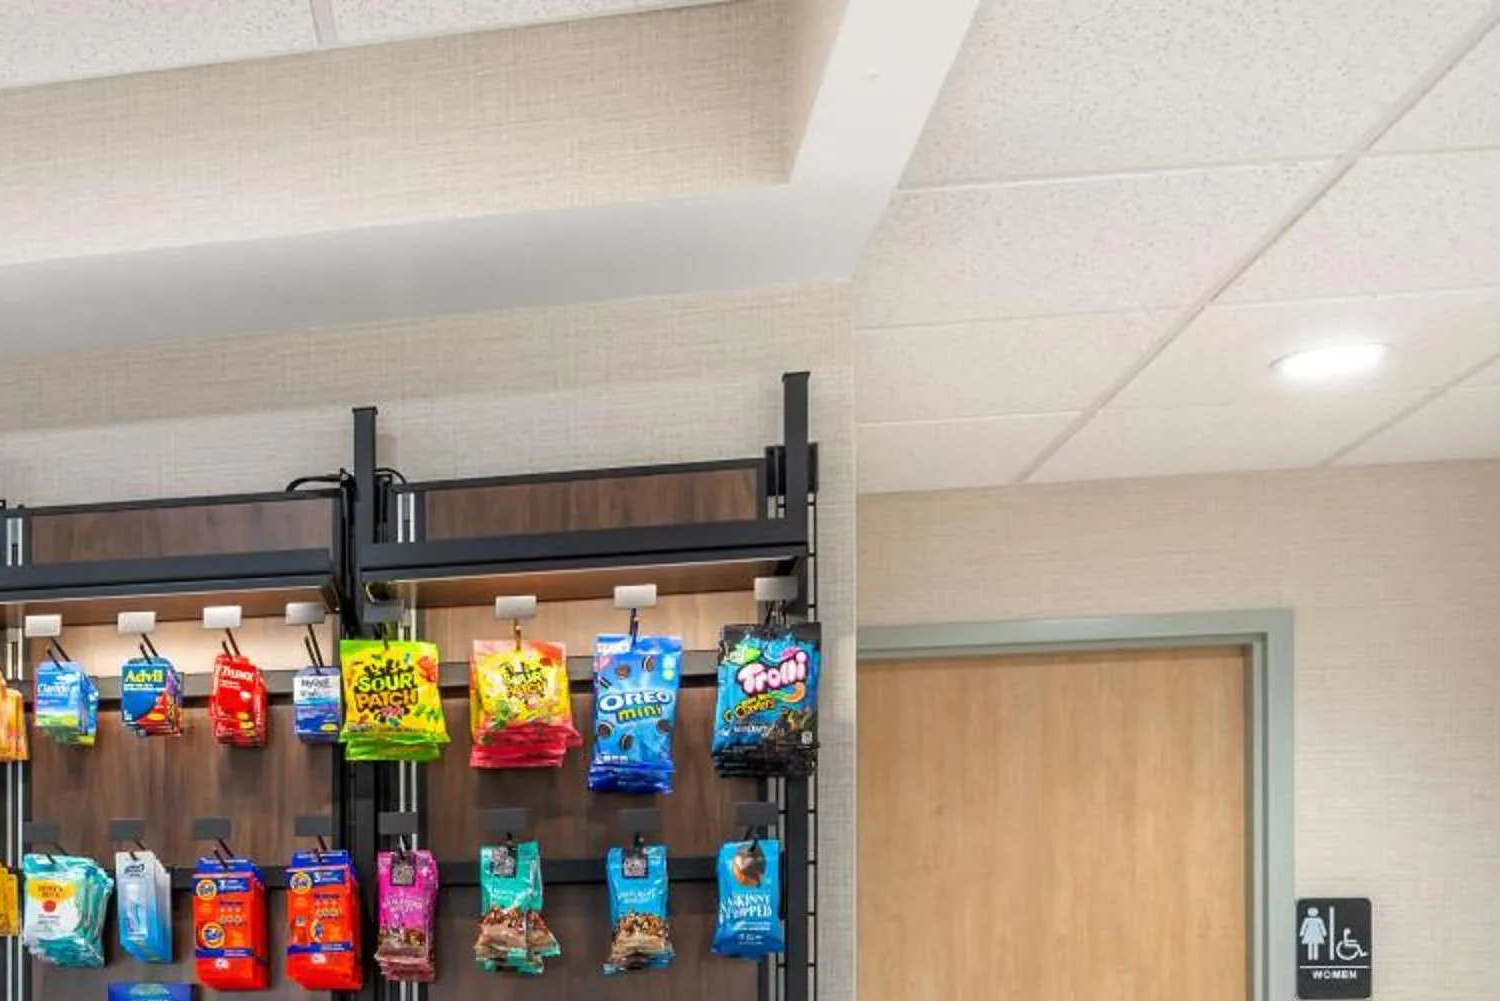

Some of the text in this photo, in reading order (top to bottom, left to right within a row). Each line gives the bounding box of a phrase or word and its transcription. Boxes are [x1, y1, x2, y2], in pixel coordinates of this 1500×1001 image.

[125, 669, 165, 683] Advil
[738, 651, 807, 694] Trolli
[357, 674, 415, 692] SOUR
[356, 692, 418, 708] PATCH
[600, 690, 673, 711] OREO
[1312, 970, 1358, 980] WOMEN
